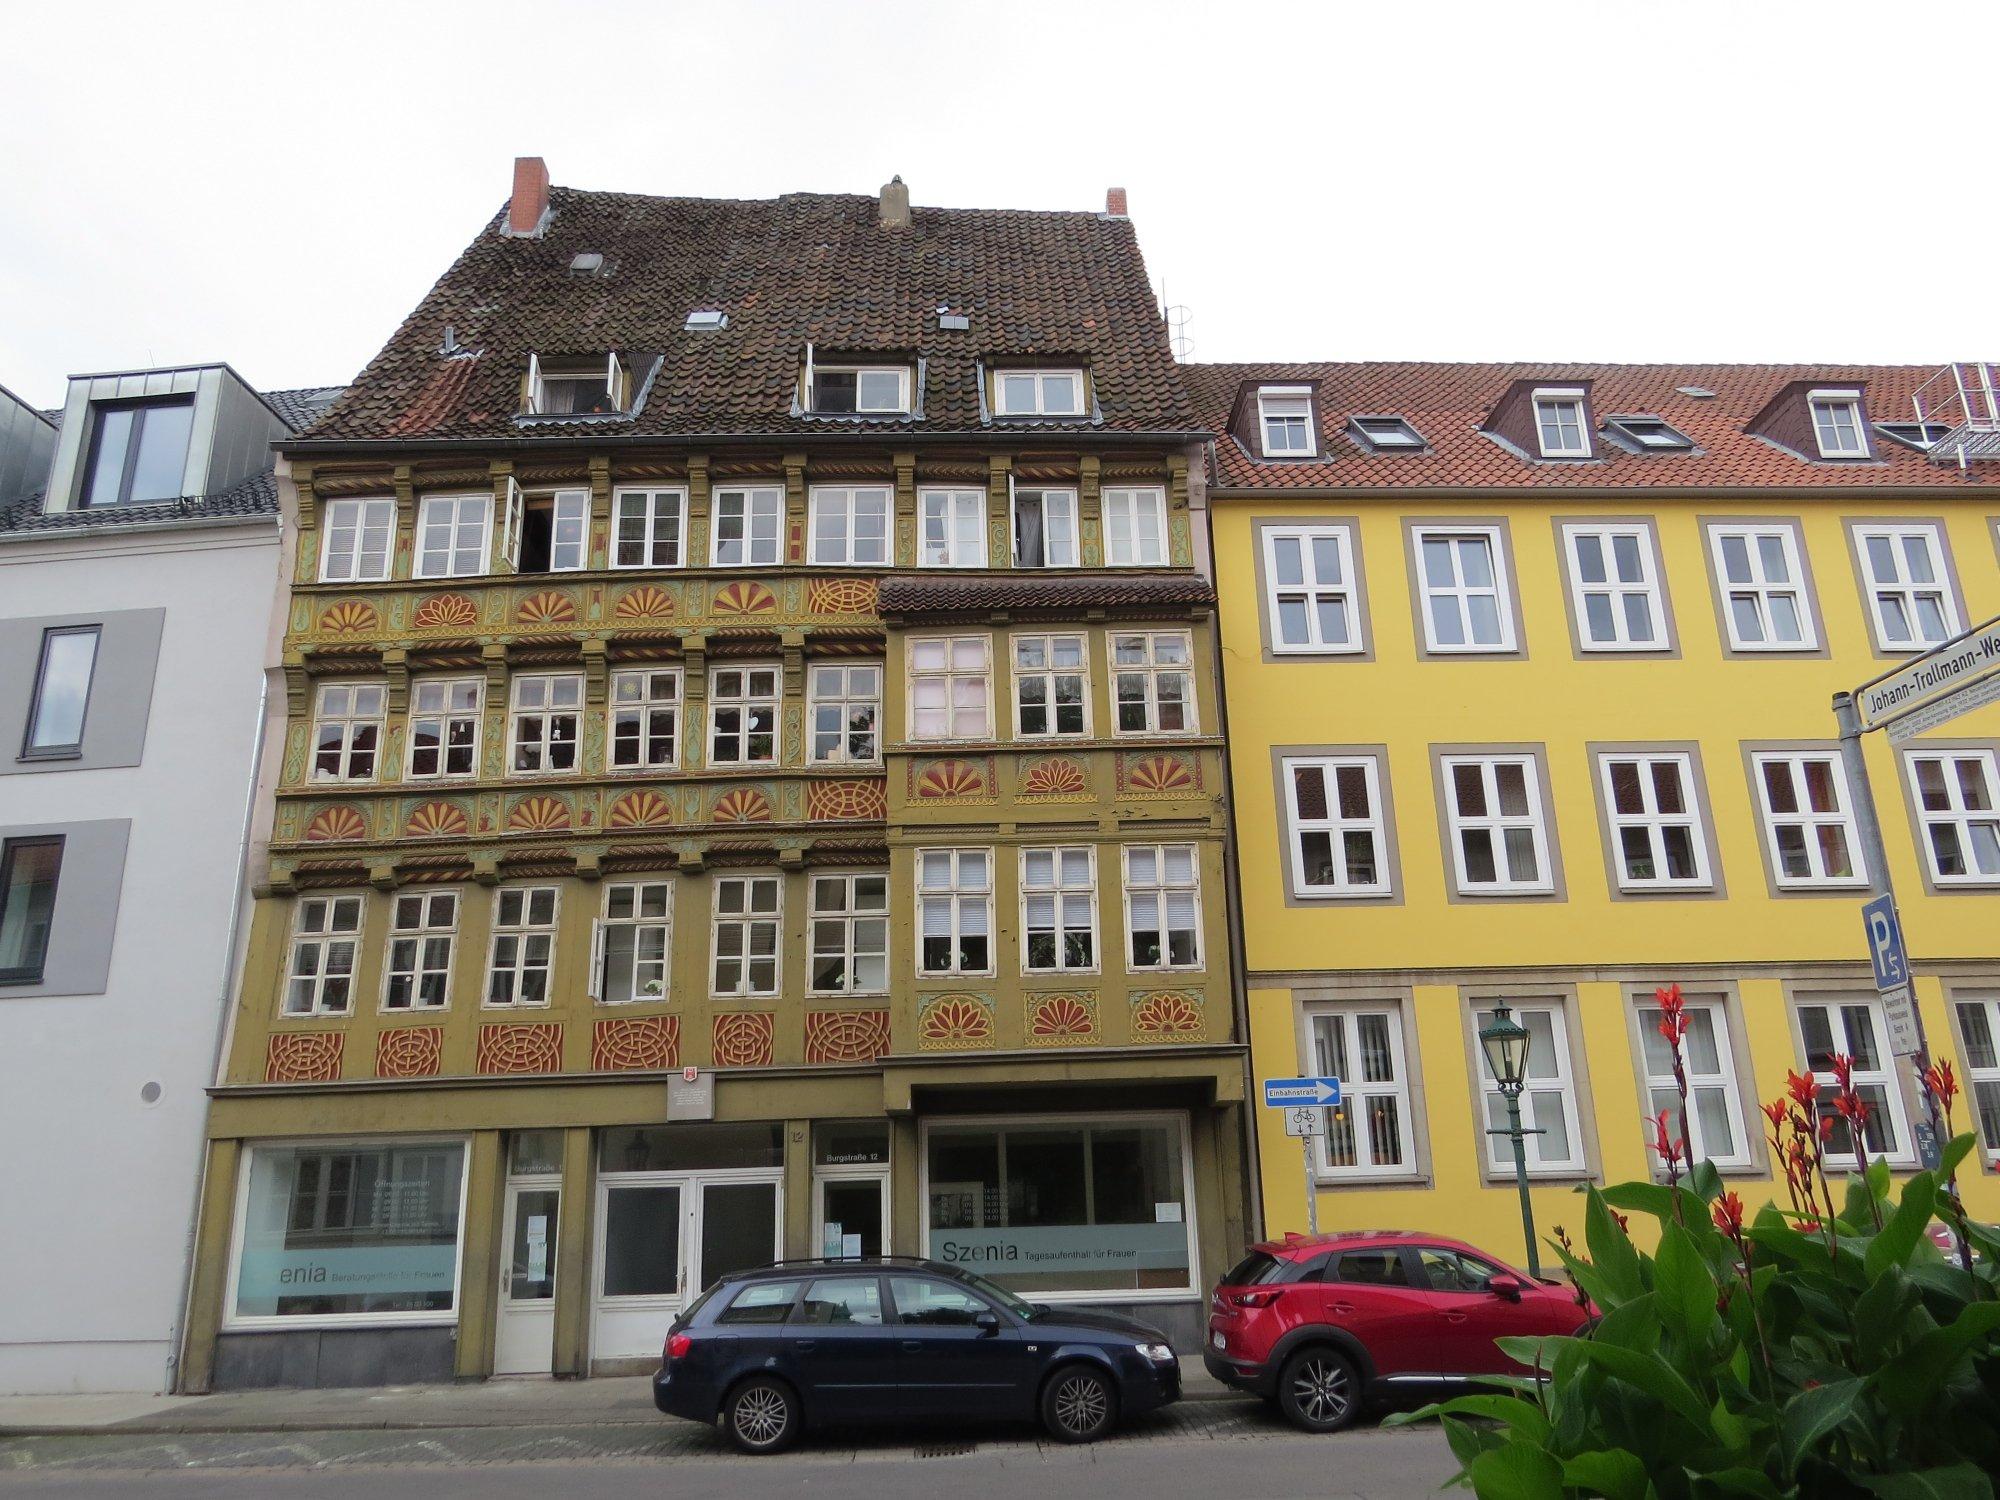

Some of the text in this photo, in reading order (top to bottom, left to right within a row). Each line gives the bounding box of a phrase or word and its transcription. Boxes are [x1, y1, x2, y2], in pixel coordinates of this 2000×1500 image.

[1870, 911, 1891, 977] P
[1269, 1089, 1318, 1097] Einbahnstraße
[793, 1131, 804, 1143] 12
[826, 1153, 867, 1162] Burgstraße
[942, 1240, 1018, 1262] Szenia
[1025, 1249, 1091, 1262] Tagesaufenthalt
[1107, 1249, 1137, 1258] Frauen
